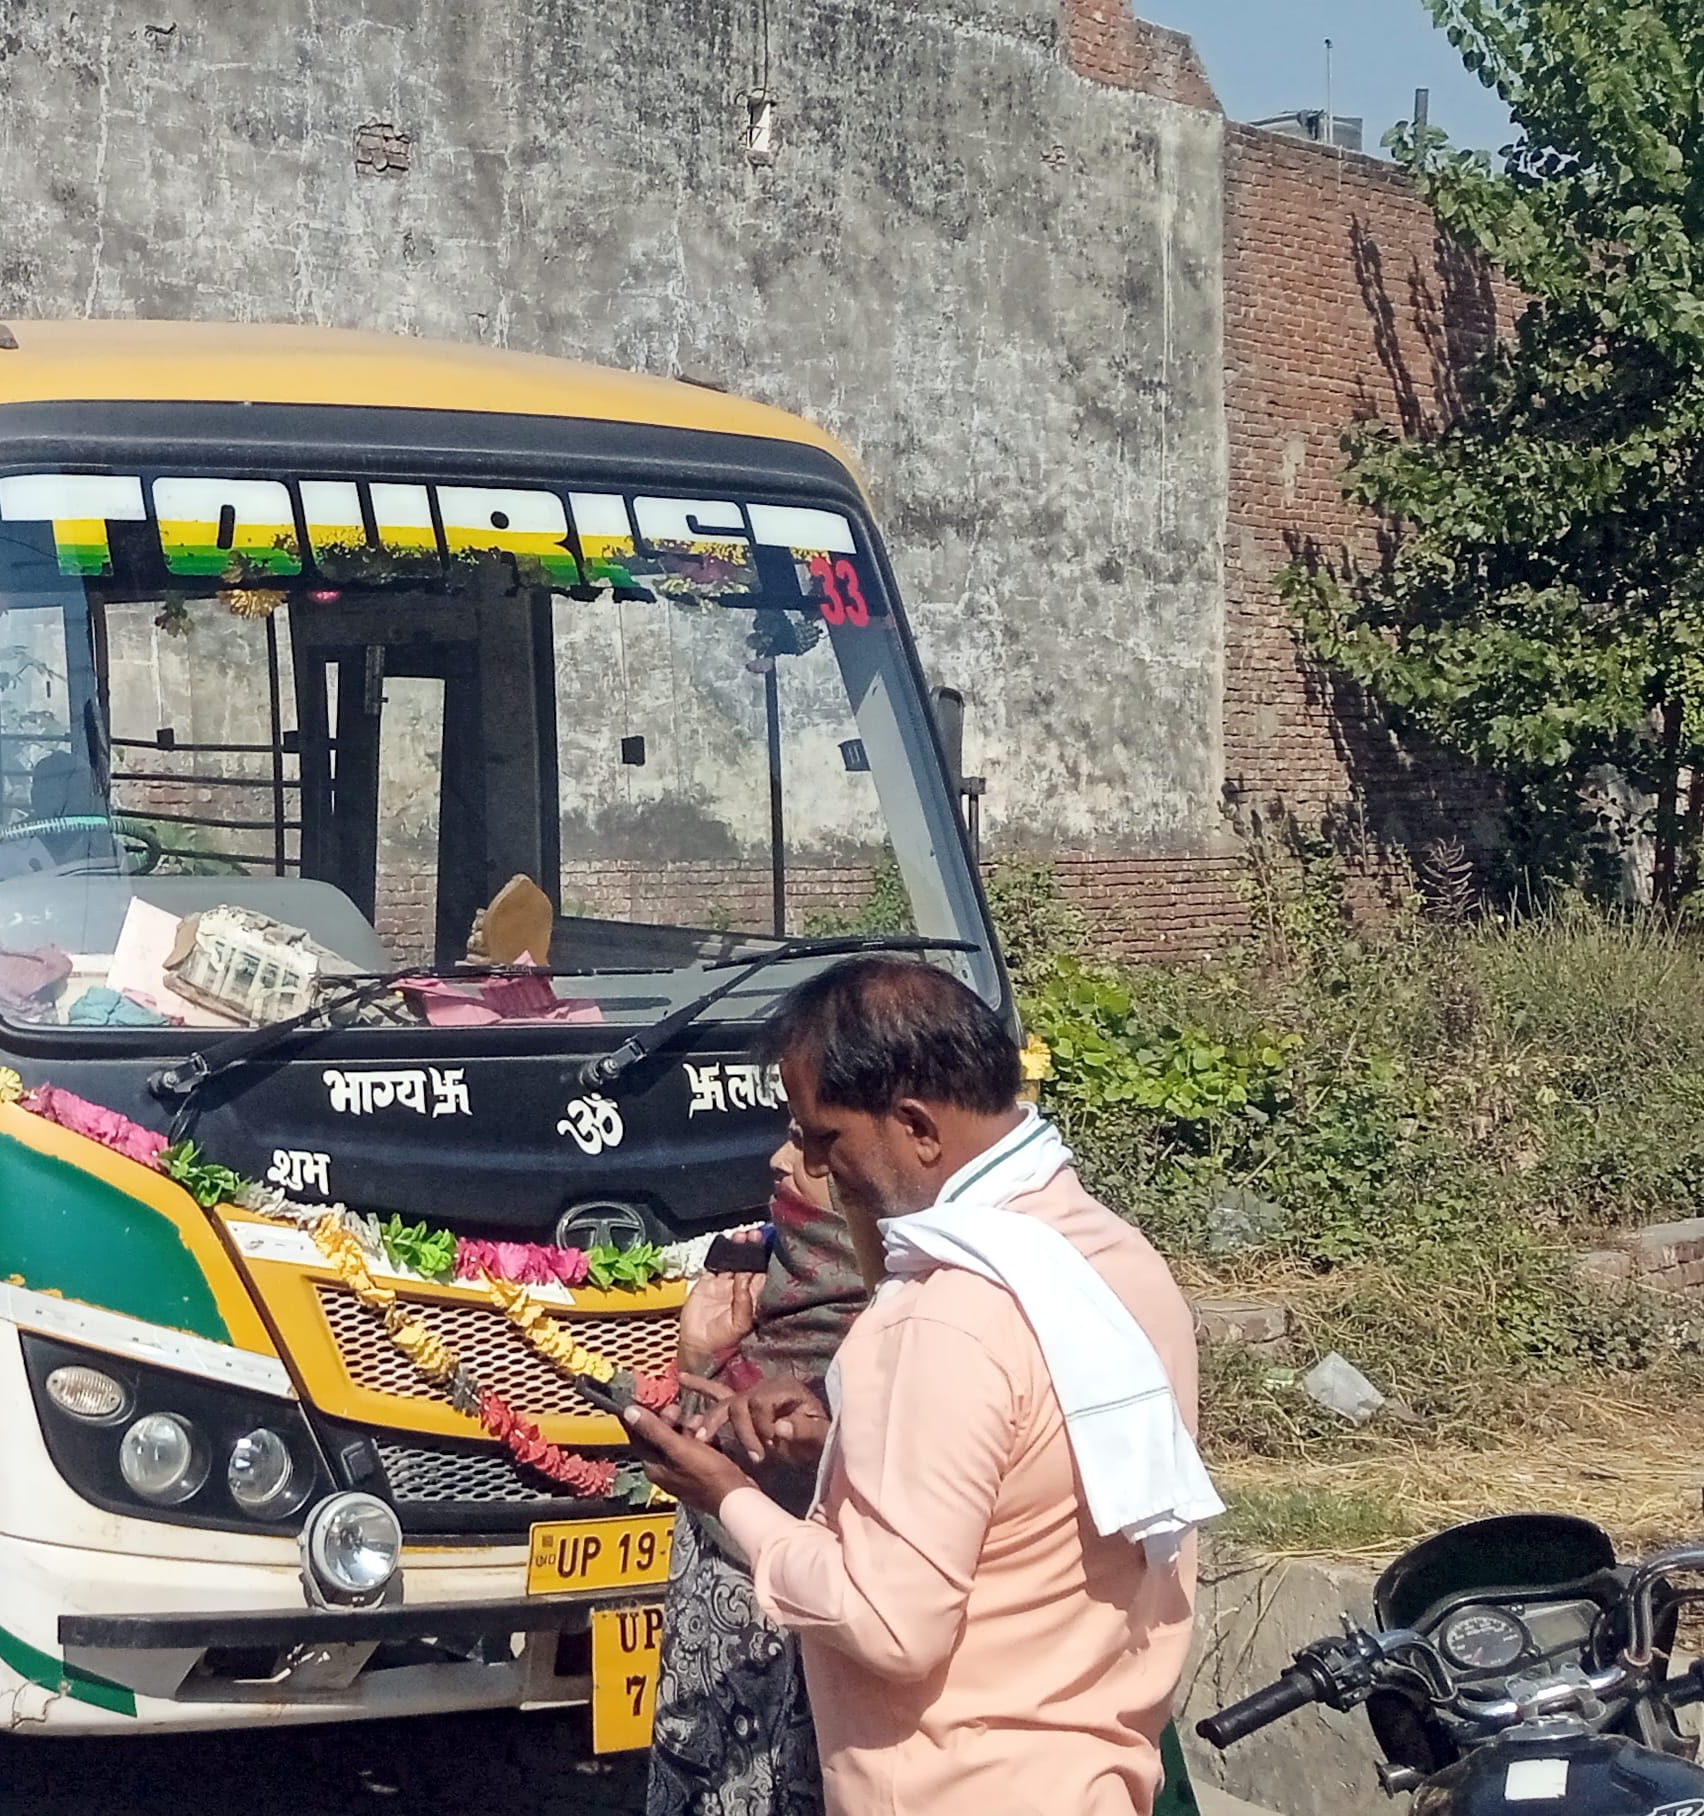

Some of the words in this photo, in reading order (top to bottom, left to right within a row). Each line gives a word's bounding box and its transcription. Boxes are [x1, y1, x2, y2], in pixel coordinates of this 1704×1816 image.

[810, 557, 870, 628] 33
[321, 1068, 427, 1117] भाग्य
[266, 1148, 332, 1197] शुभ
[557, 1535, 602, 1578] UP
[616, 1608, 664, 1653] UP
[626, 1675, 647, 1717] 7
